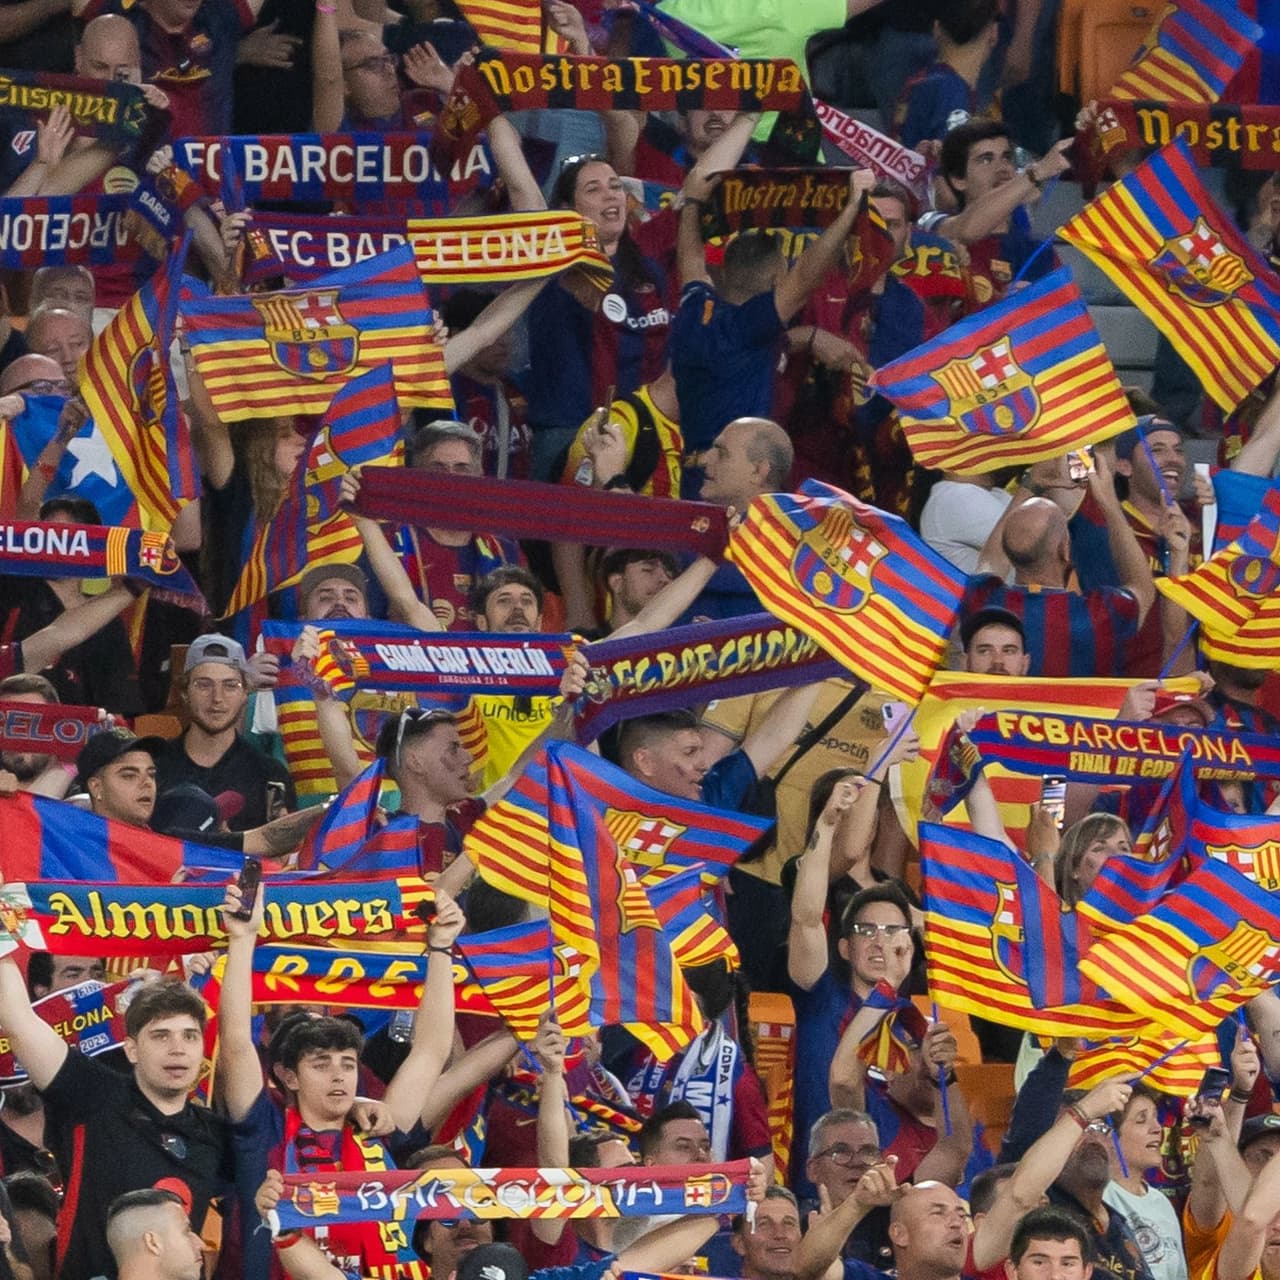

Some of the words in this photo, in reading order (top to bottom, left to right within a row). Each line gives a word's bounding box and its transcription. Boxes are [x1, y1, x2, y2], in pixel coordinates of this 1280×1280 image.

[484, 56, 621, 98] Nostra
[634, 56, 802, 104] Ensenya
[270, 229, 315, 265] FC
[0, 524, 91, 558] LONA
[433, 646, 474, 675] CAP
[998, 718, 1251, 767] FCBARCELONA
[1070, 752, 1116, 774] FINAL
[1118, 756, 1136, 776] DE
